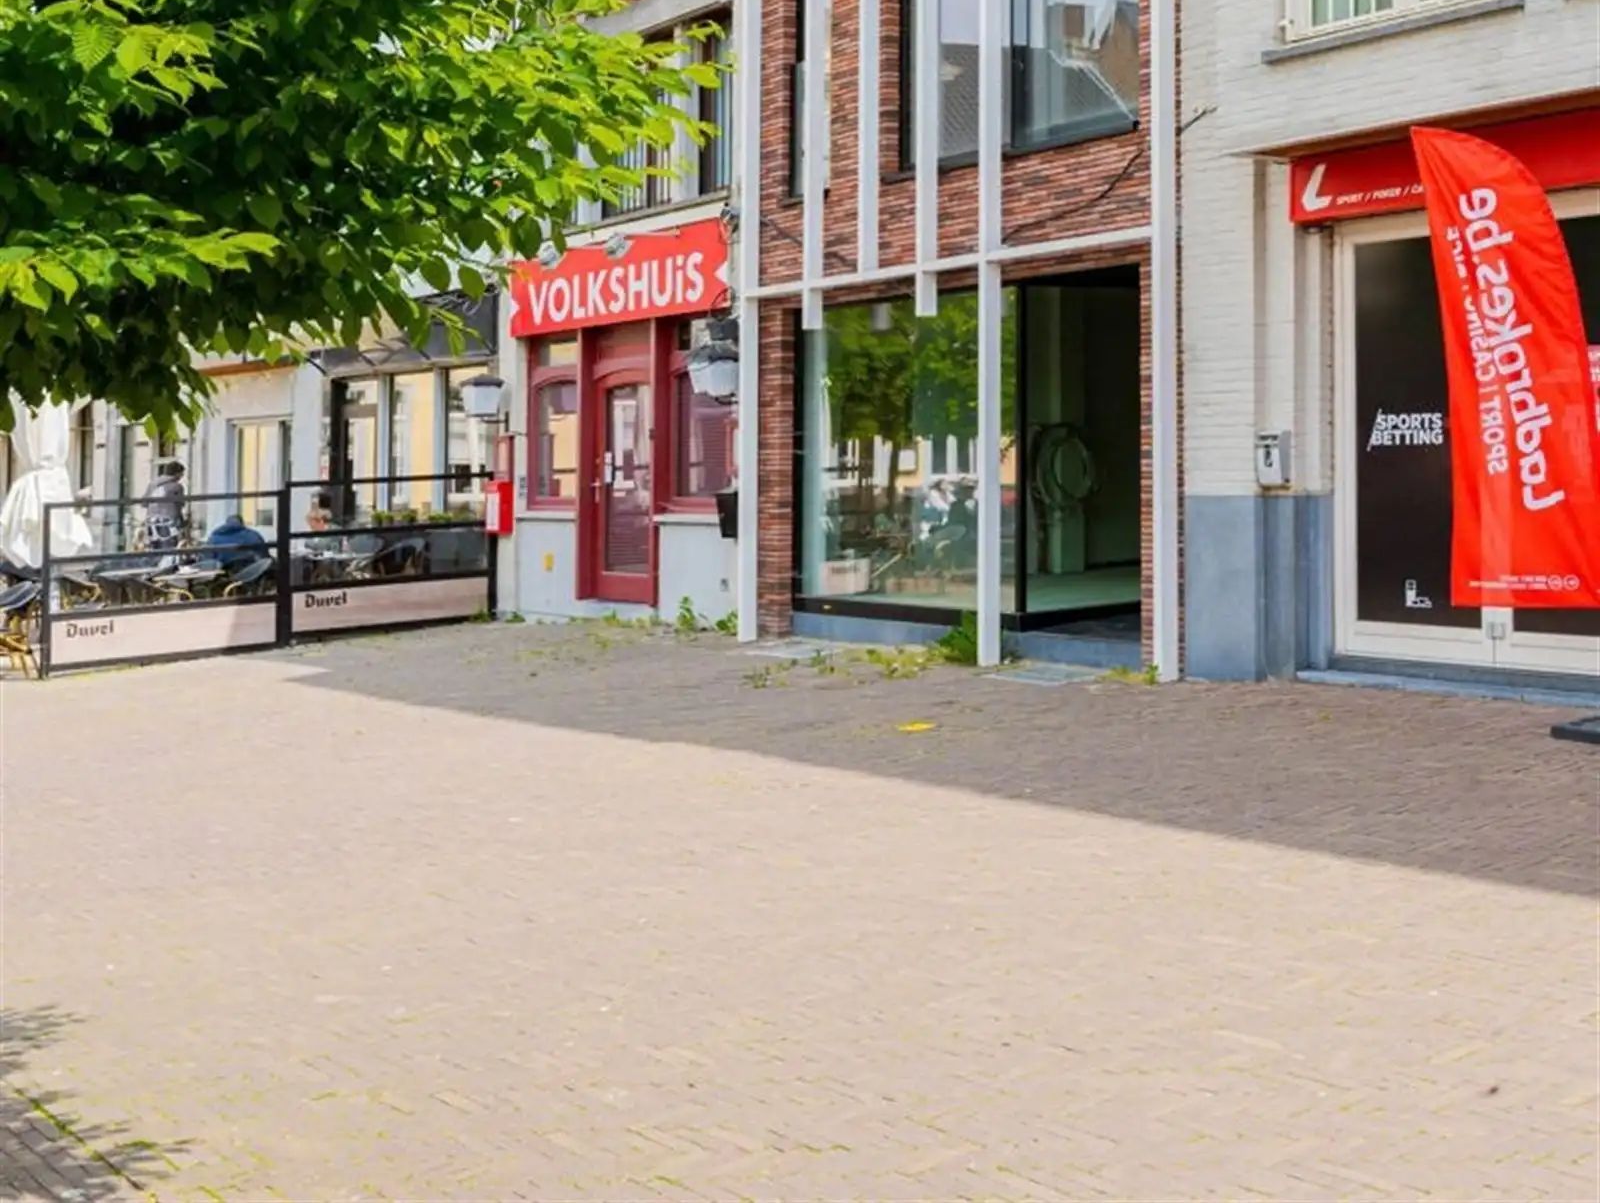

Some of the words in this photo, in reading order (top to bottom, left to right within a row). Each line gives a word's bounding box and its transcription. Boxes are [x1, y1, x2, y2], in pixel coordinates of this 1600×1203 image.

[1371, 428, 1444, 445] BETTING
[304, 591, 348, 609] Duvel
[66, 620, 114, 639] Duvel
